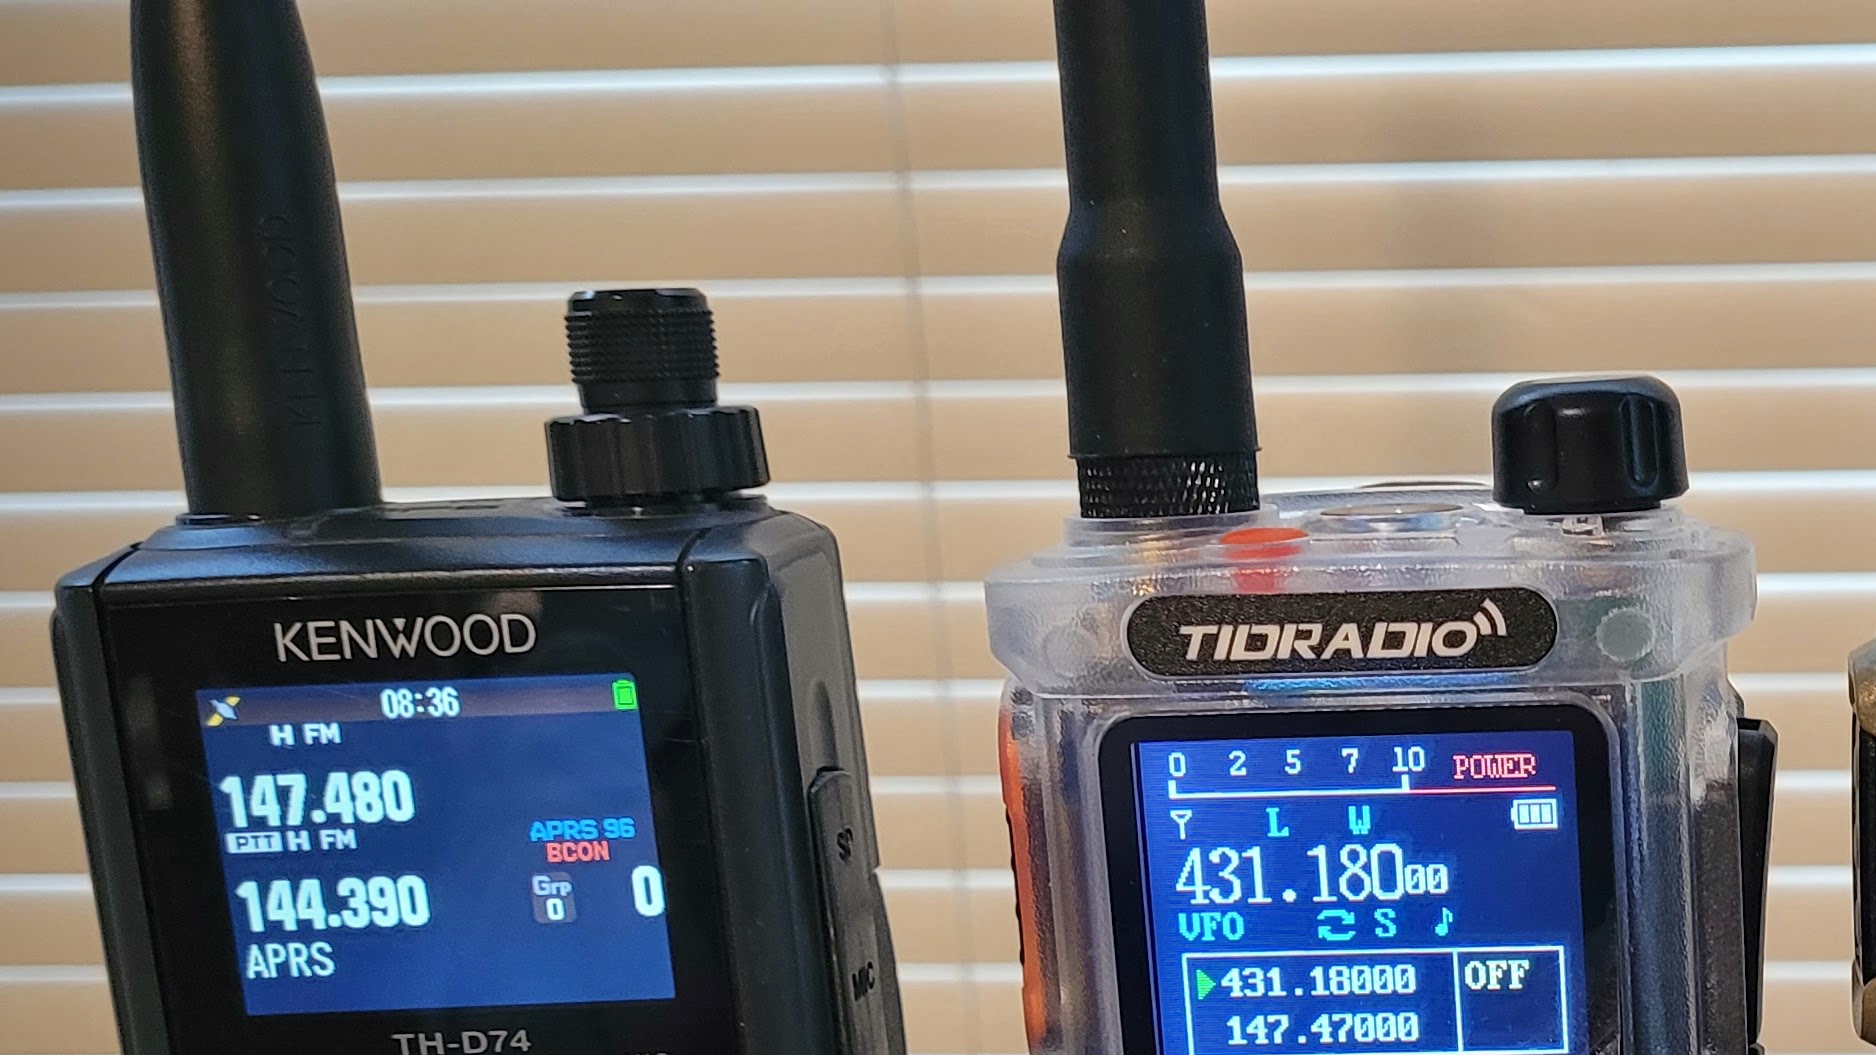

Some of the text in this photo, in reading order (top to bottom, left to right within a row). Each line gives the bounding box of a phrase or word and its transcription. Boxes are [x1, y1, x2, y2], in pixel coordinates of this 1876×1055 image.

[273, 613, 537, 663] KENWOOD
[1180, 621, 1477, 660] TIDRADIO
[380, 687, 461, 720] 08:36
[269, 722, 343, 747] H FM
[1168, 745, 1538, 780] 0 2 5 7 10 POWER
[219, 769, 417, 830] 147.480
[528, 818, 636, 842] APRS 96
[1266, 804, 1371, 838] L W
[232, 828, 358, 853] PTT H FM
[546, 841, 611, 864] BCON
[531, 874, 573, 897] Grp
[631, 864, 666, 917] 0
[235, 874, 432, 933] 144.390
[545, 898, 566, 921] 0
[1177, 908, 1397, 942] VFO S
[245, 941, 335, 980] APRS
[1463, 959, 1530, 991] OFF
[1220, 962, 1417, 998] 431.18000
[1225, 1012, 1420, 1046] 147.47000
